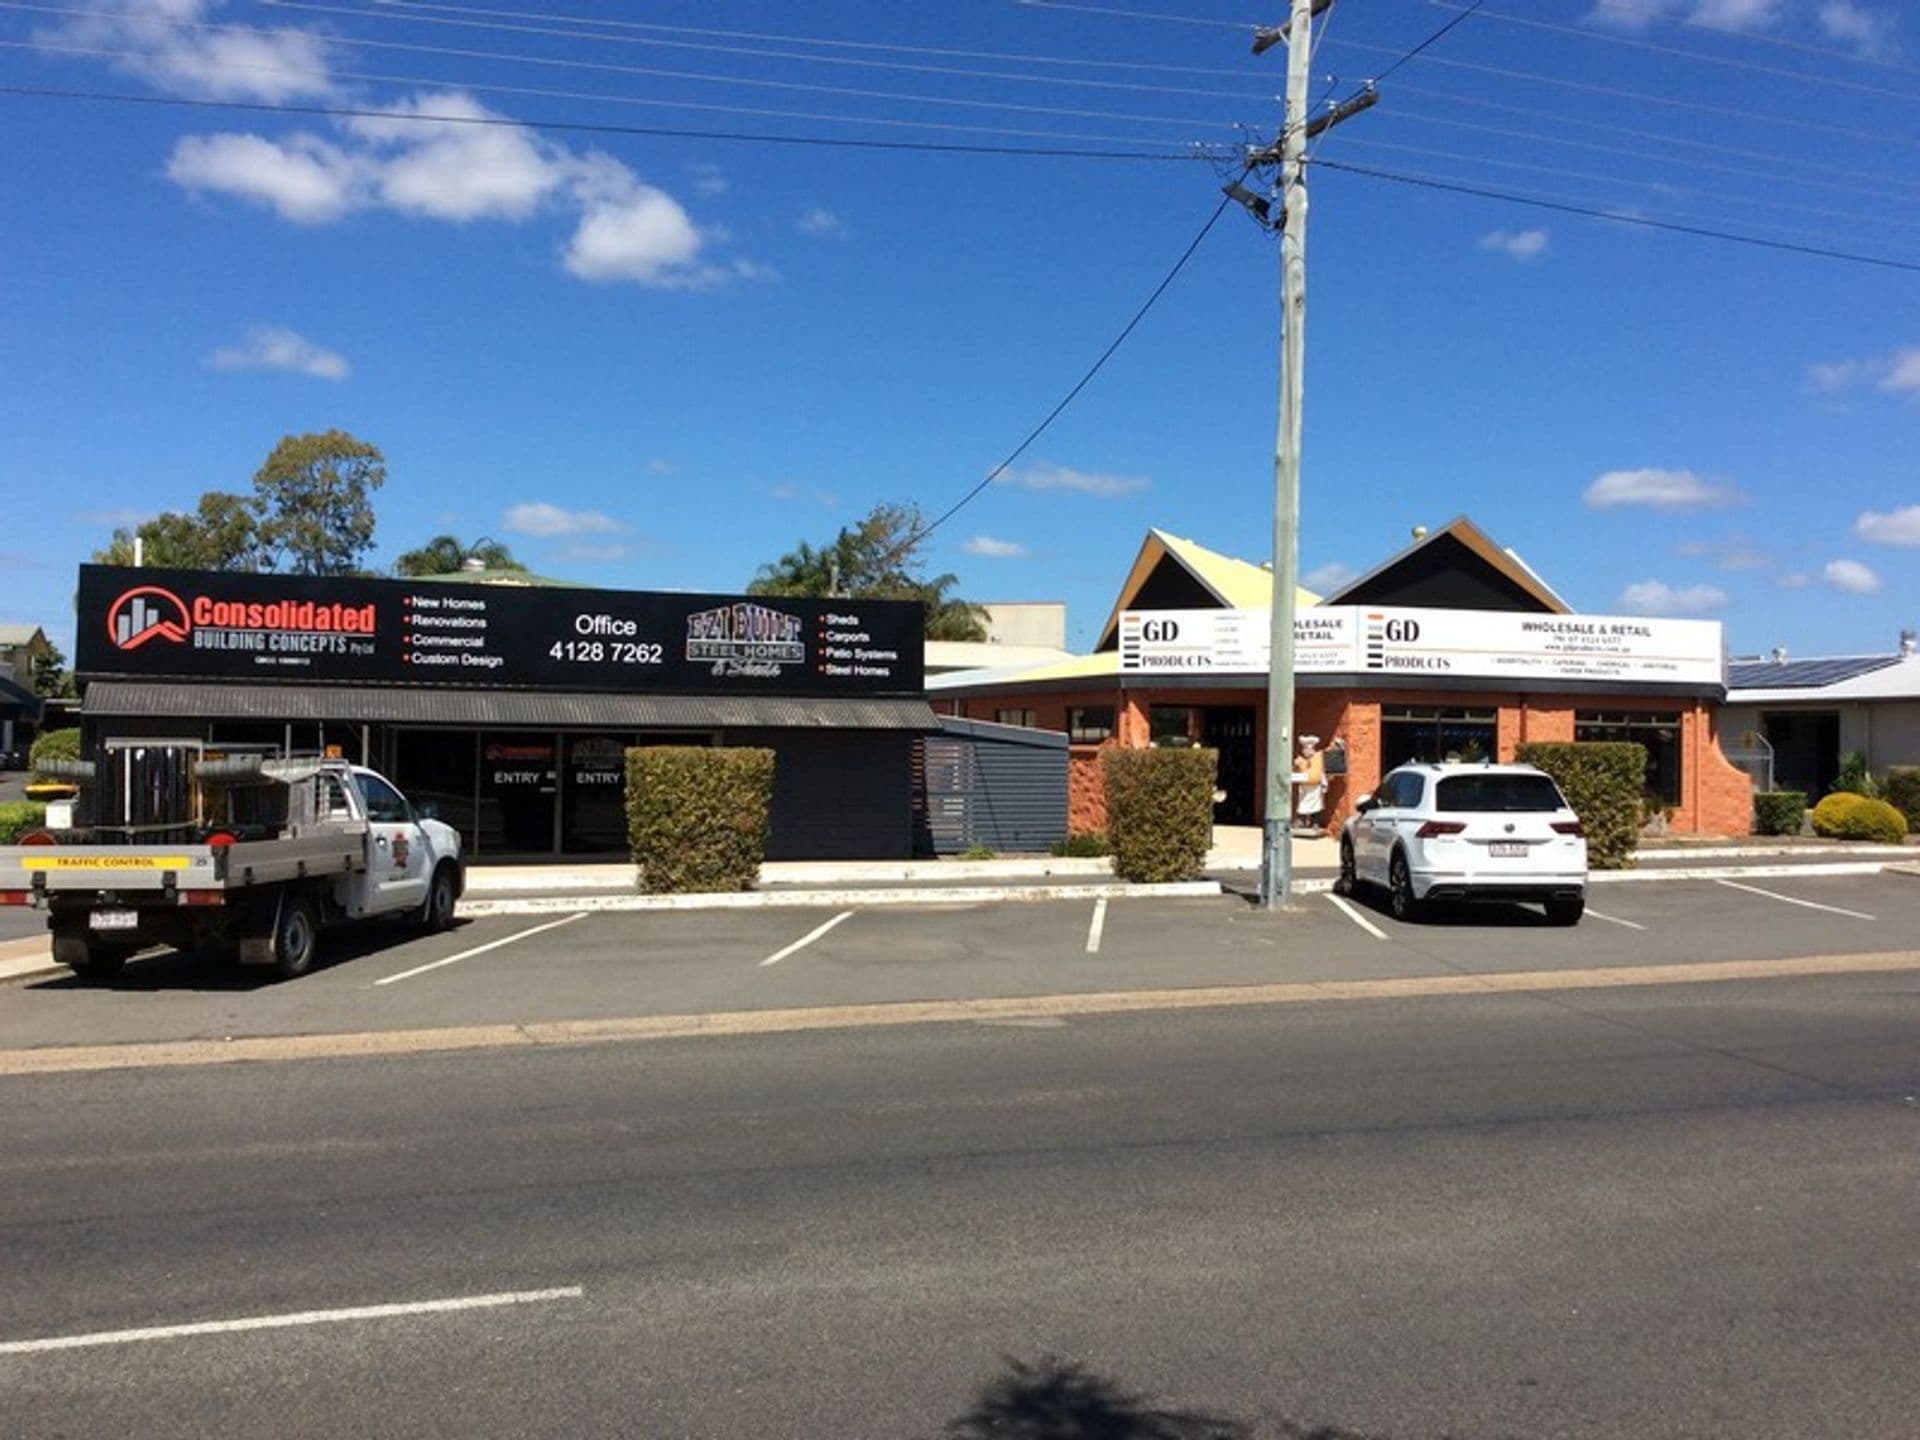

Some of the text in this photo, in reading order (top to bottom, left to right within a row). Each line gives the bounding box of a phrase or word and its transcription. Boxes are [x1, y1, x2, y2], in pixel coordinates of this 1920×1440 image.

[412, 596, 486, 611] New Homes
[193, 597, 376, 633] Consolidated
[411, 614, 487, 629] Renovations
[826, 613, 859, 626] Sheds
[575, 614, 638, 636] Office
[1142, 619, 1179, 642] GD
[1385, 619, 1420, 643] GD
[1521, 621, 1652, 638] WHOLESALE & RETAIL
[194, 631, 265, 650] BUILDING
[269, 633, 348, 654] CONCEPTS
[412, 634, 484, 648] Commercial
[825, 630, 870, 644] Carports
[549, 641, 663, 664] 4128 7262
[689, 644, 802, 659] STEEL HOMES
[826, 646, 898, 662] Patio Systems
[411, 652, 503, 669] Custom Design
[1142, 654, 1212, 668] PRODUCTS
[1385, 655, 1451, 670] PRODUCTS
[826, 663, 890, 677] Steel Homes
[494, 772, 540, 785] ENTRY
[576, 772, 621, 785] ENTRY
[57, 858, 155, 868] TRAFFIC CONTROL
